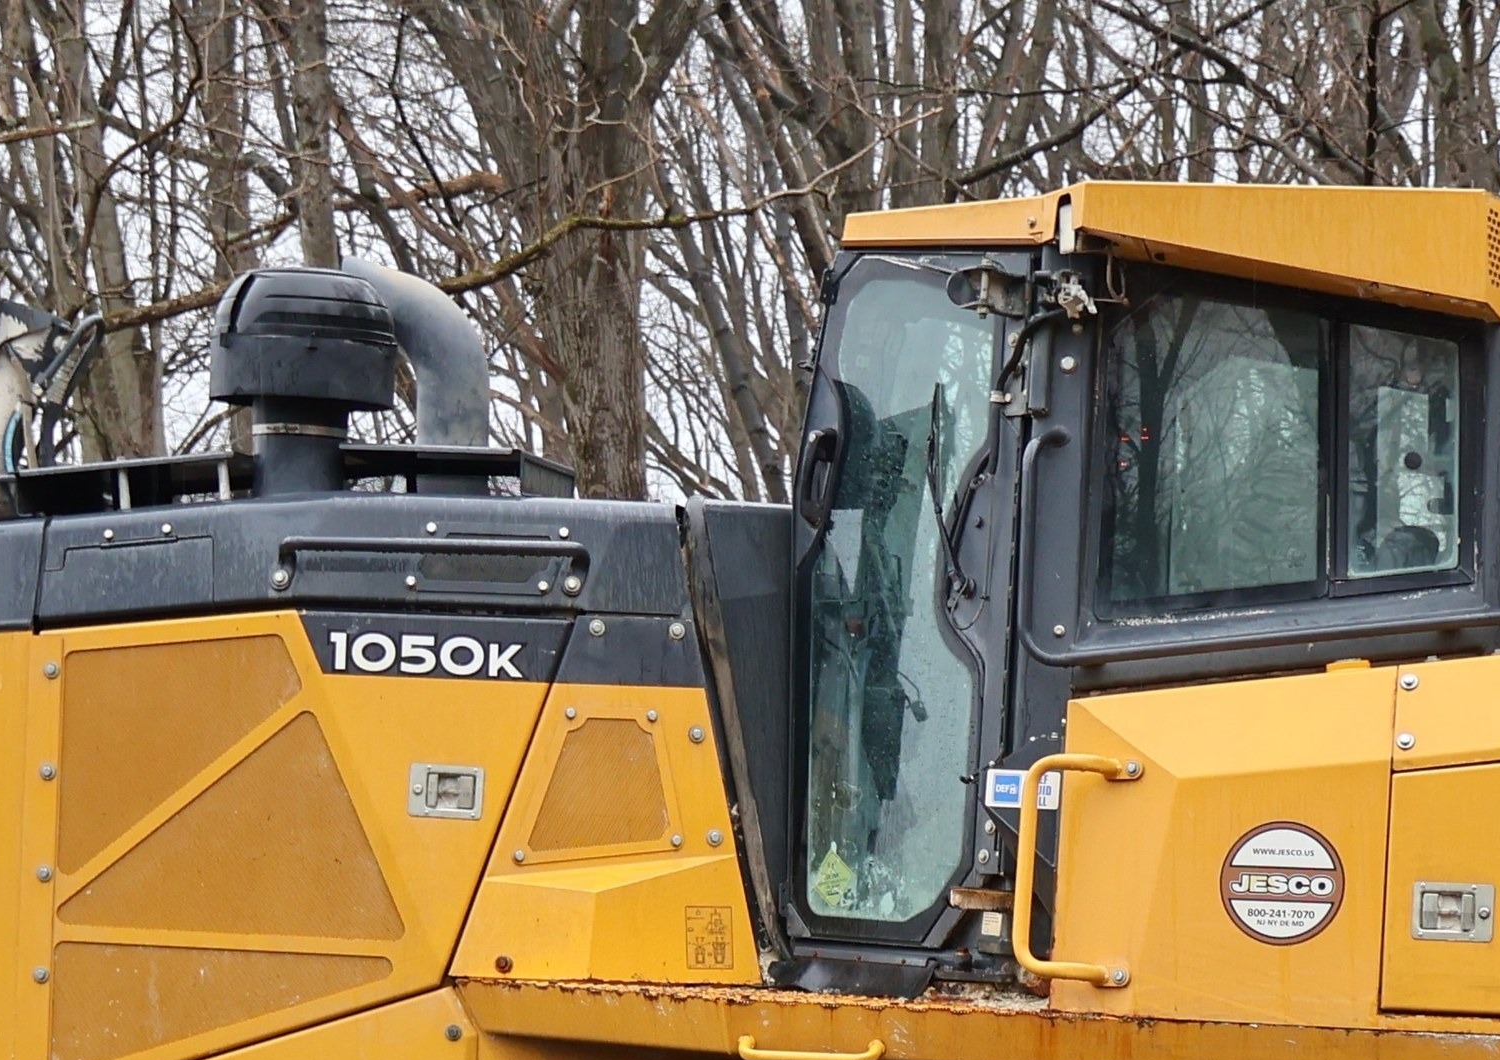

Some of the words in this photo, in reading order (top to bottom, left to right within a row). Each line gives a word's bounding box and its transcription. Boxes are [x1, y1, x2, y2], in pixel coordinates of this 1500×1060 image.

[330, 631, 523, 679] 1050K
[996, 784, 1010, 793] DEF
[1252, 848, 1315, 857] WWW.JESCO.US
[1230, 873, 1335, 897] JESCO
[1247, 908, 1316, 919] 800-241-7070
